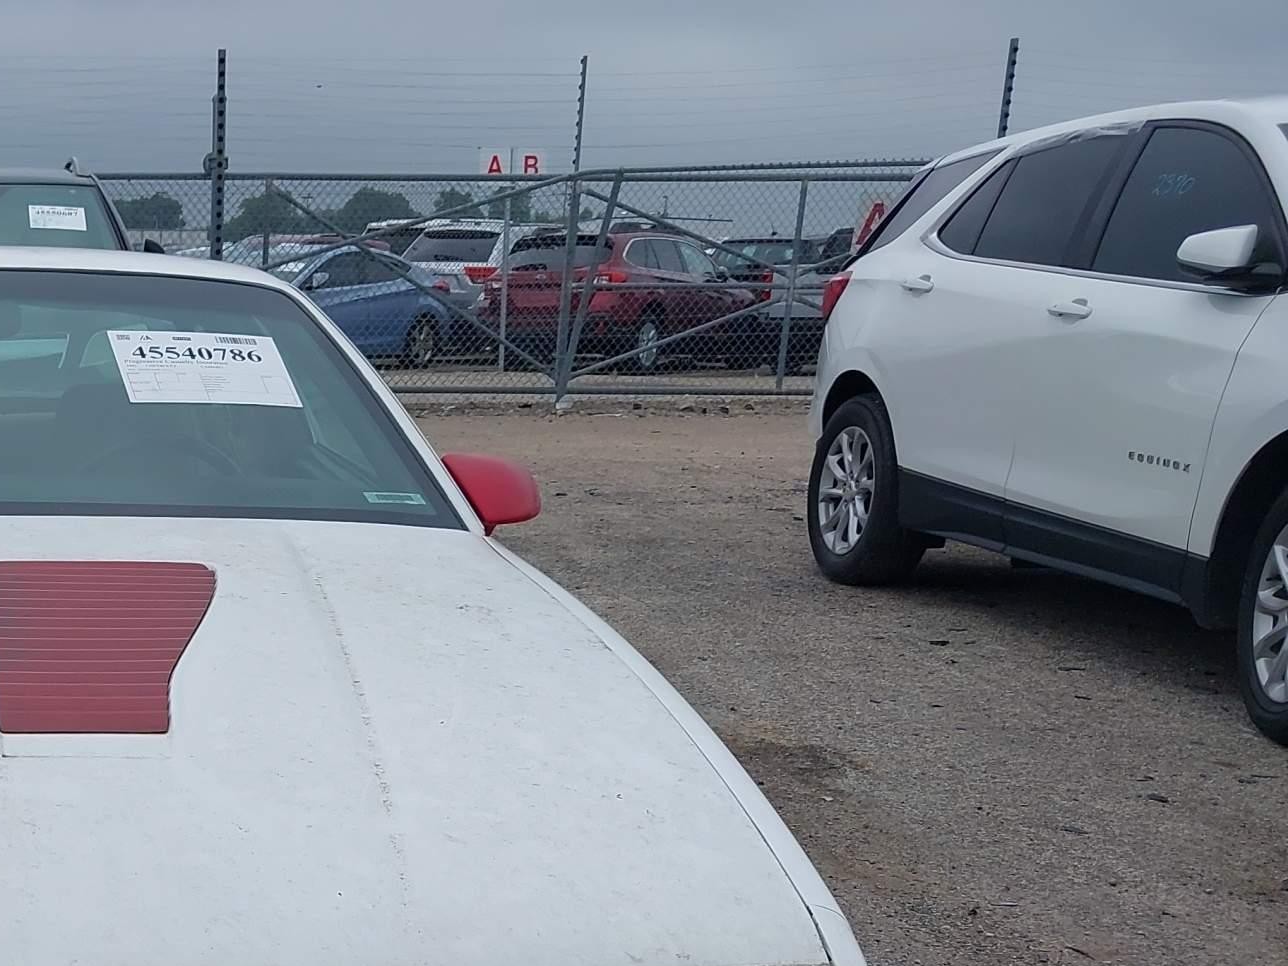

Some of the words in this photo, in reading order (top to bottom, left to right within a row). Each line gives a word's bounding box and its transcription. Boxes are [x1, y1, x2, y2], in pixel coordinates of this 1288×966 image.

[488, 154, 502, 175] A
[132, 346, 262, 363] 45540786
[1128, 451, 1191, 473] EQUINOX
